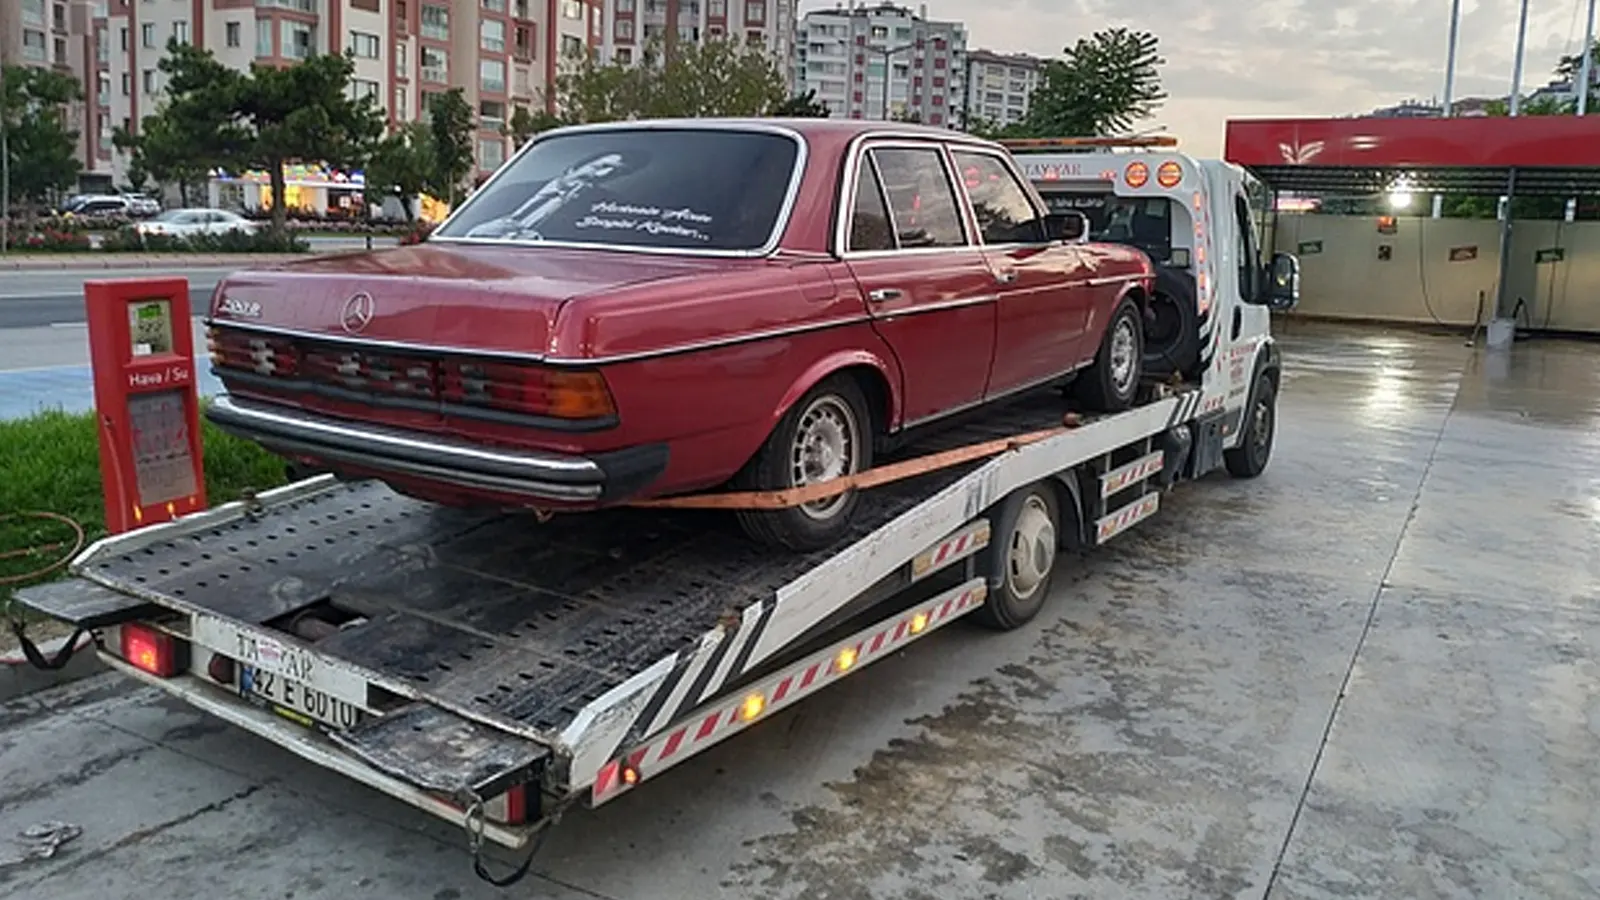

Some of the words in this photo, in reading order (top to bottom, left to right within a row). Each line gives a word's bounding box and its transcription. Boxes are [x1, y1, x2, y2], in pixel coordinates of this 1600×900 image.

[129, 371, 163, 387] Hava
[172, 368, 189, 382] Su
[253, 667, 275, 697] 42
[283, 678, 296, 705] E
[303, 684, 354, 728] 6010
